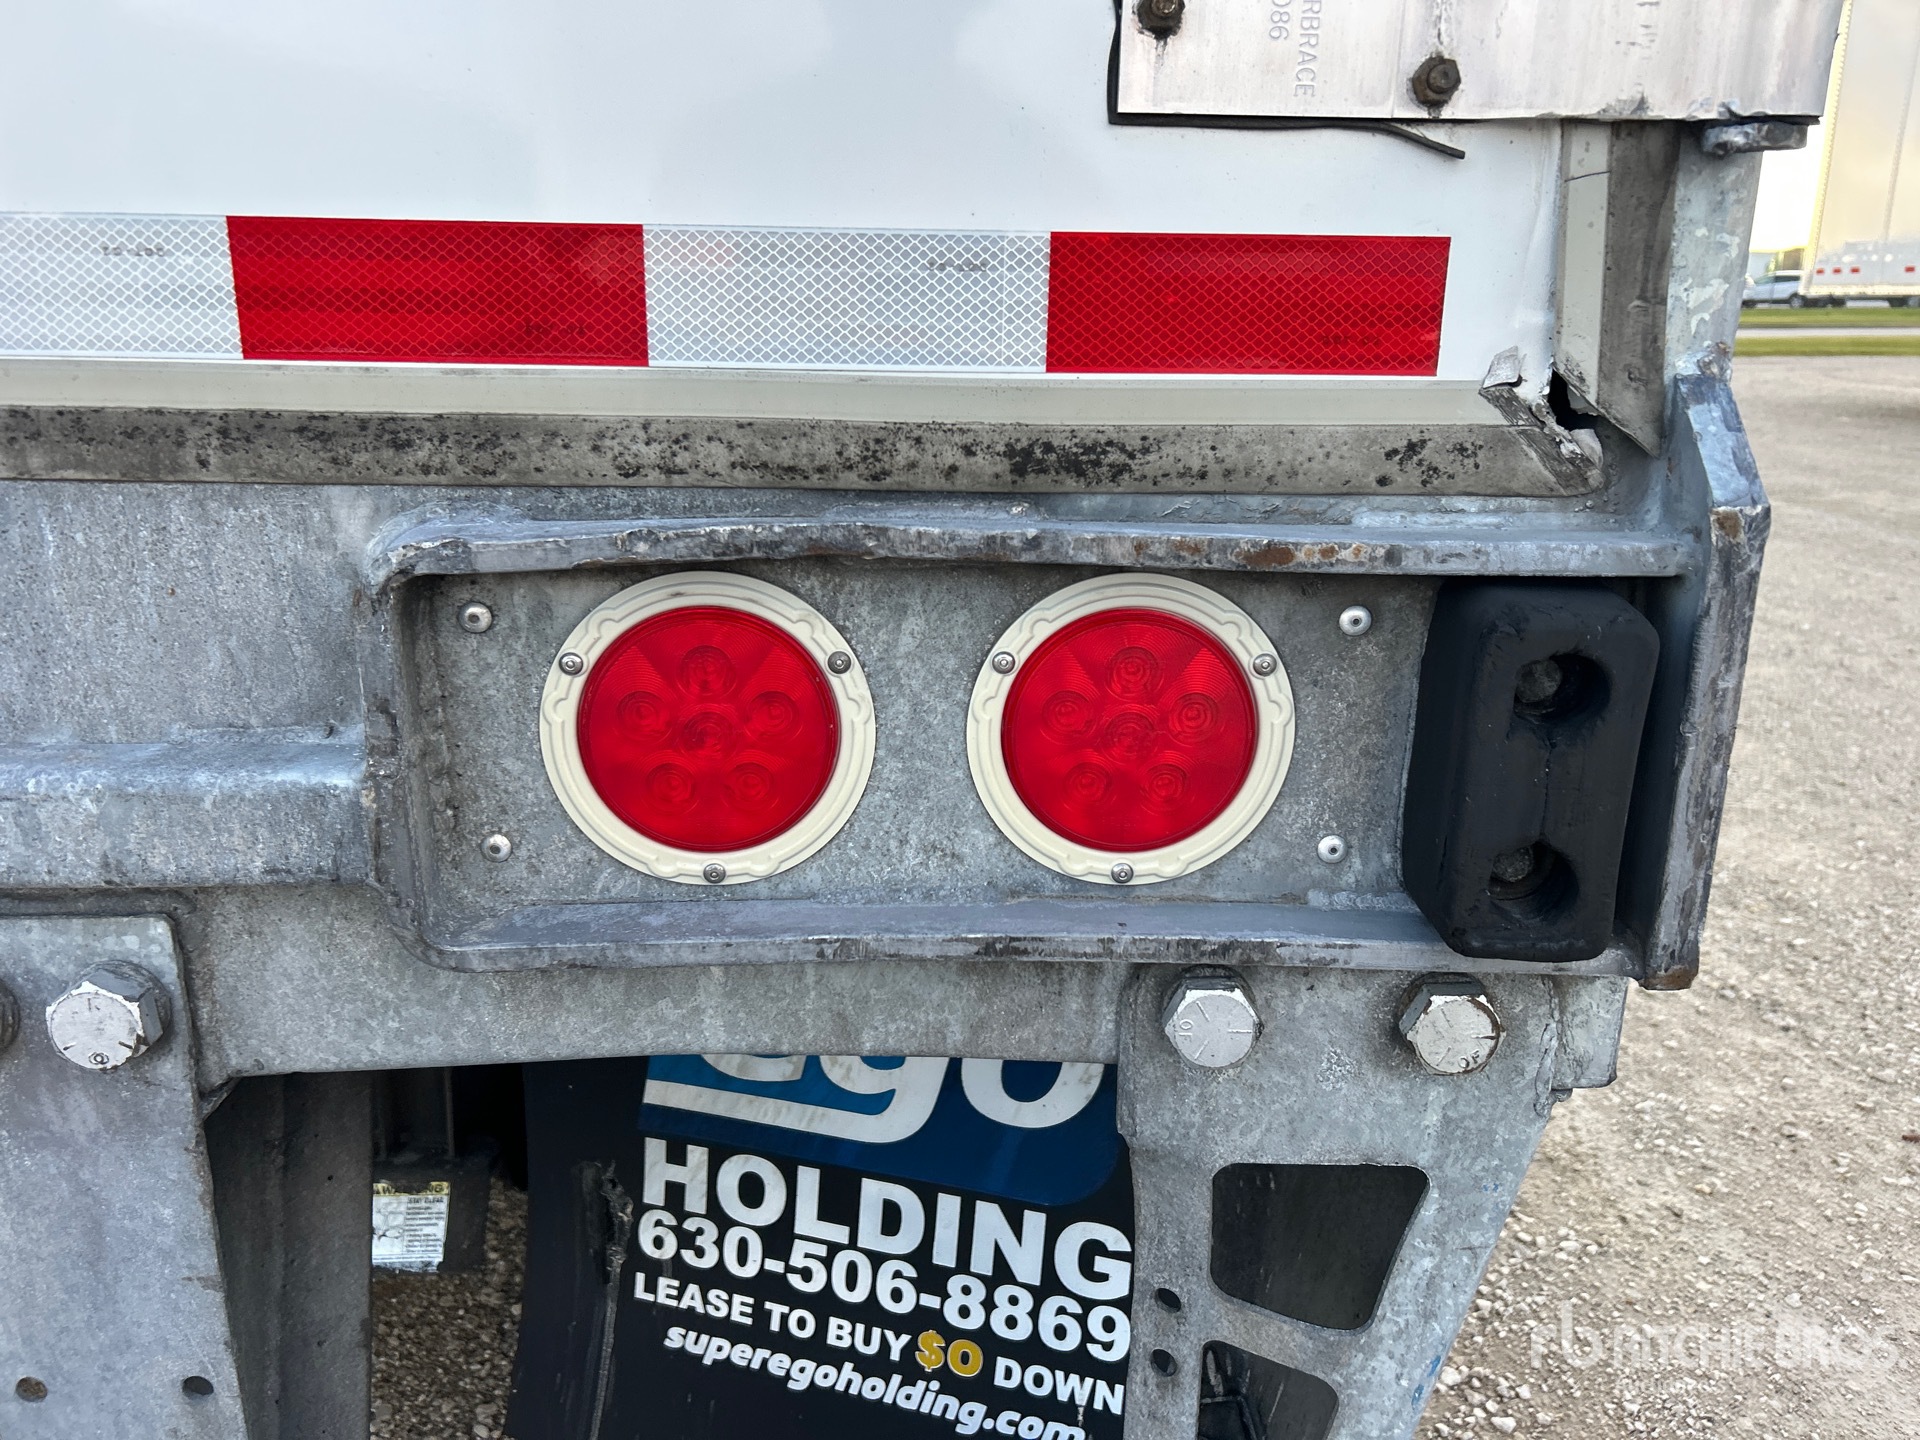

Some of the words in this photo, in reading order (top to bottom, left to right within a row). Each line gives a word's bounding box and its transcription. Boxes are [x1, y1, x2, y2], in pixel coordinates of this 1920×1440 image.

[638, 1209, 1131, 1362] 630-506-8869
[643, 1137, 1132, 1300] HOLDING
[634, 1272, 754, 1325] LEASE
[764, 1301, 816, 1338] TO
[826, 1316, 912, 1361] BUY
[915, 1330, 983, 1377] $0
[994, 1356, 1124, 1415] DOWN
[663, 1326, 1086, 1440] superegoholding.com
